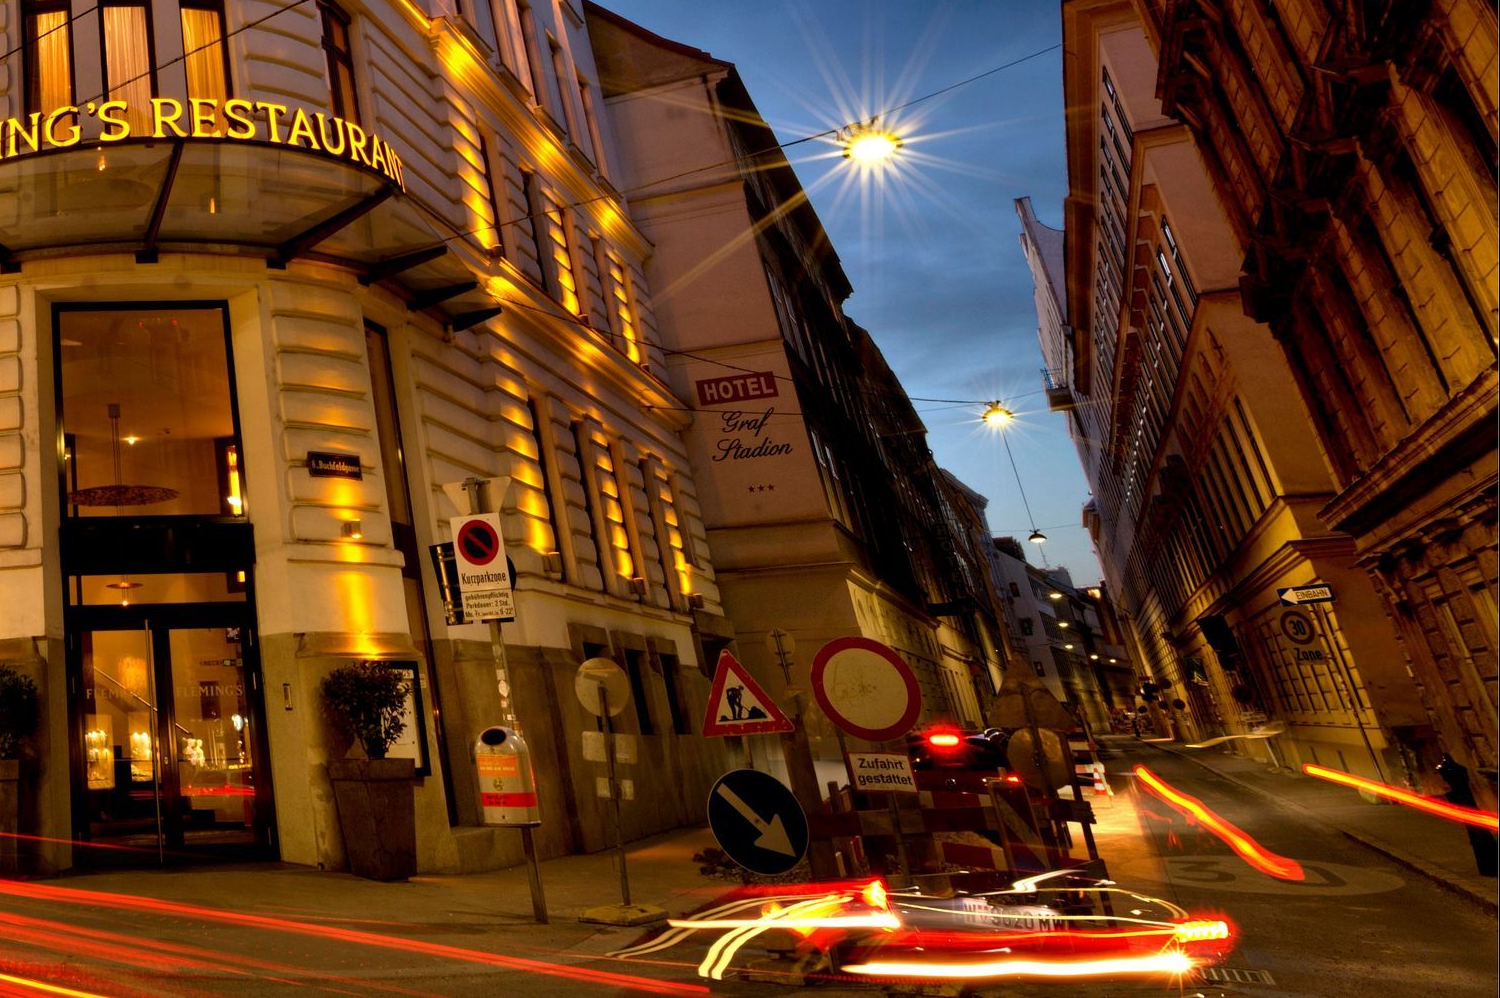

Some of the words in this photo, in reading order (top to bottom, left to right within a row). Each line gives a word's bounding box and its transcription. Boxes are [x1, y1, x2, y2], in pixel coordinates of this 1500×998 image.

[703, 376, 774, 401] HOTEL
[721, 407, 775, 437] Graf
[712, 436, 793, 462] Stadion
[461, 571, 507, 586] Kurzparkzone
[1295, 589, 1328, 600] EINBAHN
[1289, 620, 1306, 635] 30
[1293, 647, 1323, 661] Zone
[859, 757, 905, 771] Zufahrt
[858, 774, 913, 787] gestattet
